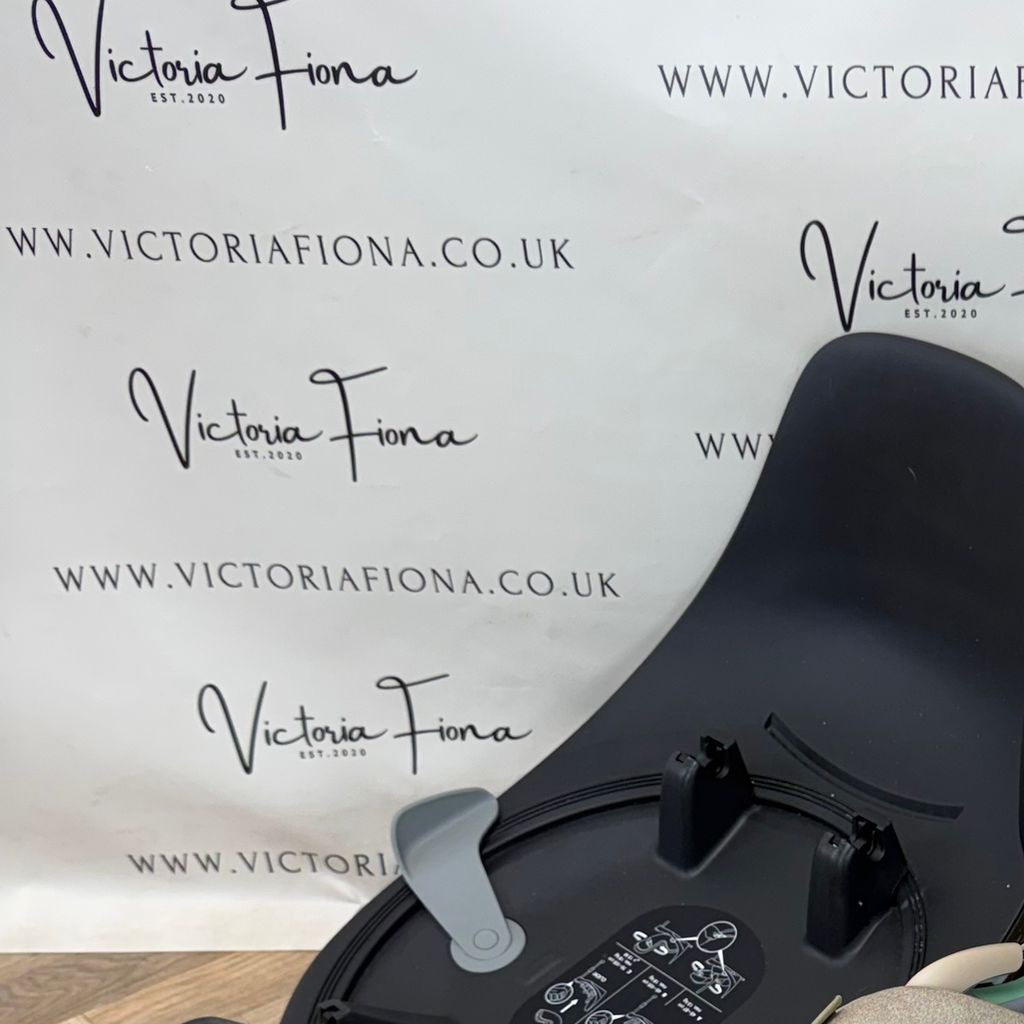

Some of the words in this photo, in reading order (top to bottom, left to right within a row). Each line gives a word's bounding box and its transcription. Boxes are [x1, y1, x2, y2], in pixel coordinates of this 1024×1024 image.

[31, 0, 248, 117] Victoria
[230, 0, 418, 131] Fiona
[150, 92, 225, 105] EST.2020
[5, 226, 575, 270] WW.VICTORIAFIONA.CO.UK
[800, 220, 1006, 333] Victoria
[905, 308, 977, 319] EST.2020
[128, 367, 323, 470] Victoria
[309, 366, 478, 483] Fiona
[235, 449, 302, 461] EST.2020
[53, 561, 621, 598] WWW.VICTORIAFIONA.CO.UK
[197, 681, 388, 775] Victoria
[375, 674, 532, 775] Fiona
[299, 746, 367, 760] EST.2020
[127, 851, 400, 877] WWW.VICTORI
